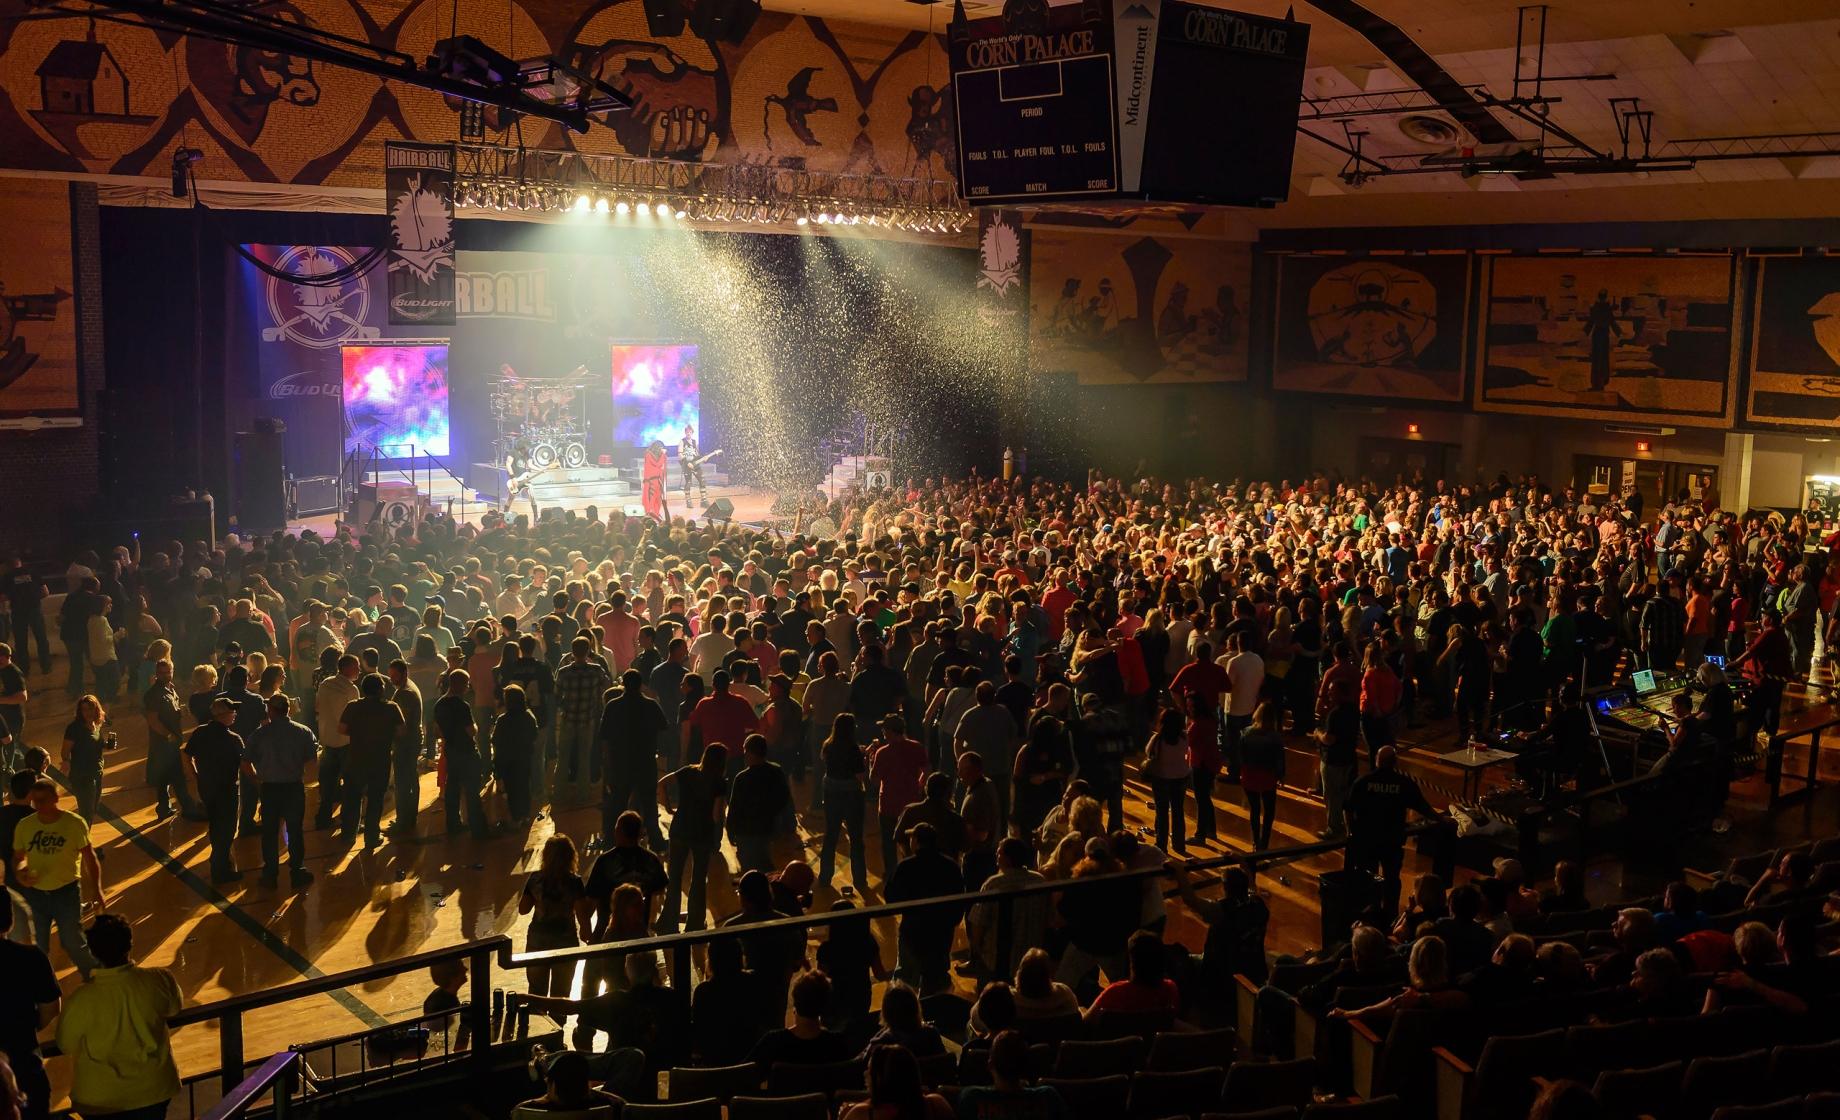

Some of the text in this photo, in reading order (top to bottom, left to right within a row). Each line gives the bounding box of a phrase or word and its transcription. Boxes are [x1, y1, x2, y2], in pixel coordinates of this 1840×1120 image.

[1184, 10, 1229, 46] CORN
[1232, 18, 1288, 55] PALACE
[966, 30, 1095, 68] CORN PALACE
[1125, 25, 1148, 126] Midcontinent
[1021, 106, 1043, 118] PERIOD
[389, 148, 450, 169] HAIRBALL
[968, 151, 987, 161] FOULS
[1014, 147, 1037, 158] PLAYER
[1039, 145, 1055, 156] FOUL
[1084, 142, 1106, 153] FOULS
[971, 179, 1108, 195] SCORE MATCH SCORE
[1367, 782, 1401, 794] POLICE
